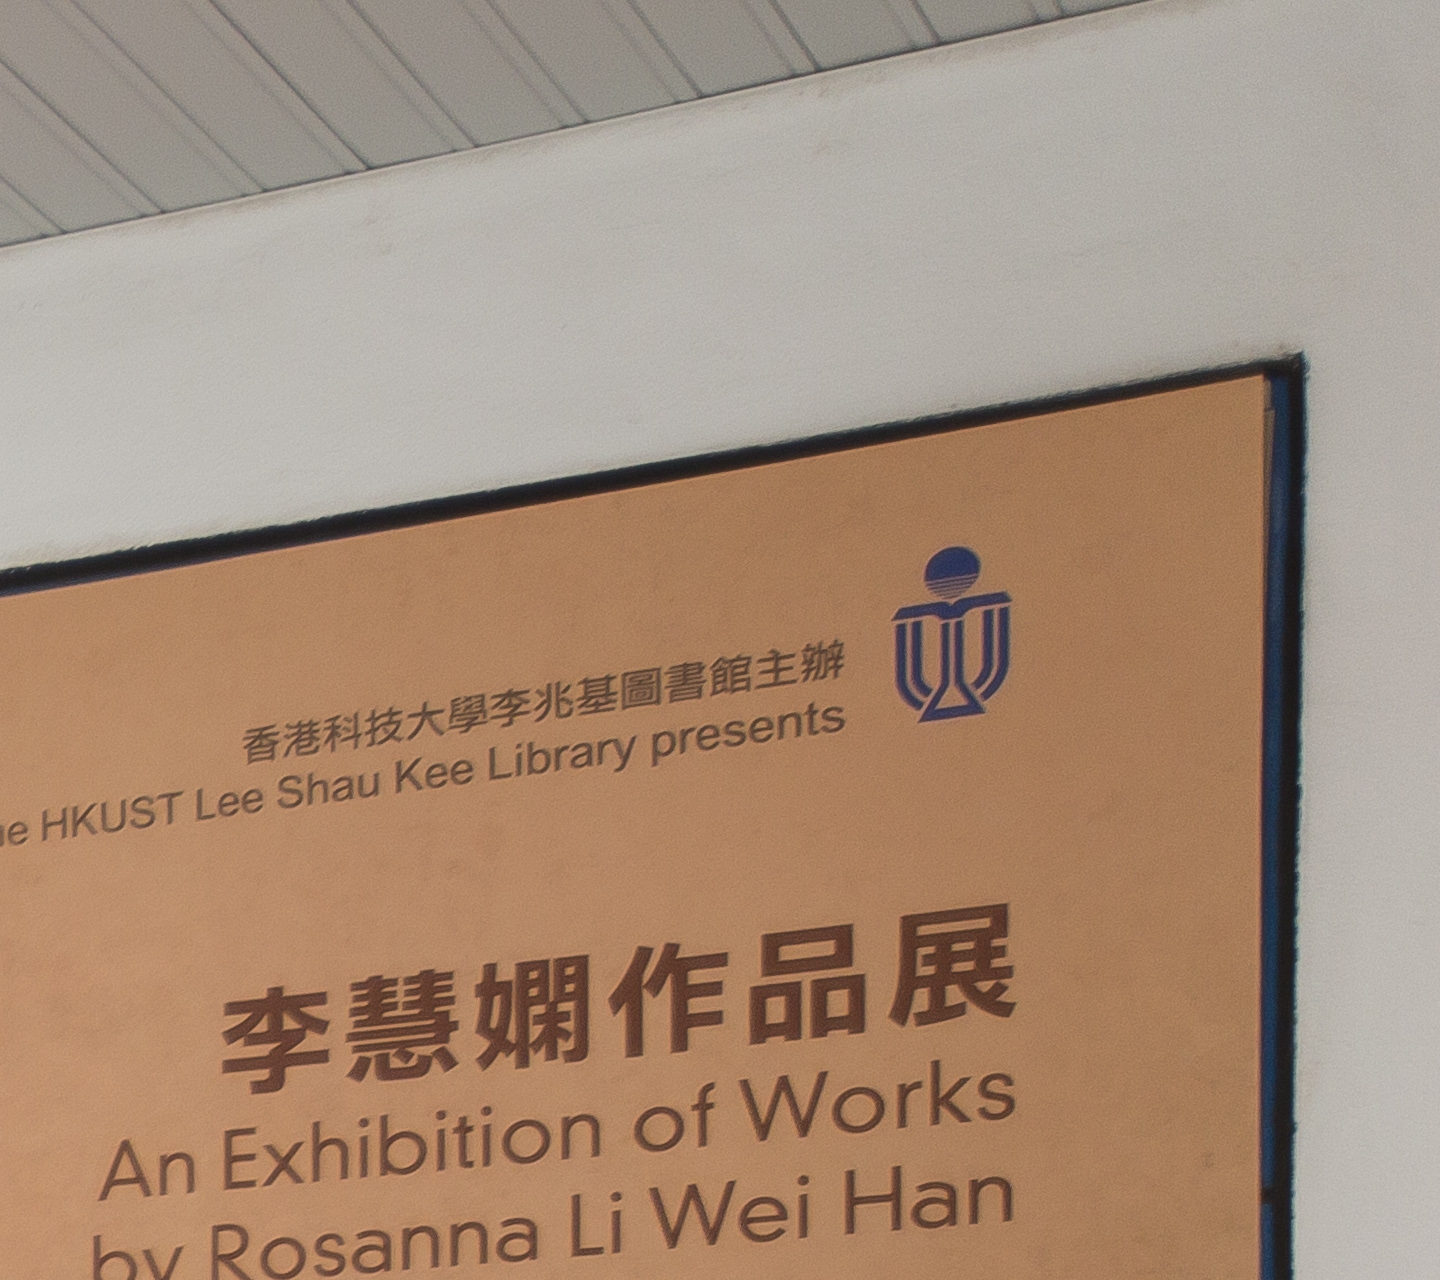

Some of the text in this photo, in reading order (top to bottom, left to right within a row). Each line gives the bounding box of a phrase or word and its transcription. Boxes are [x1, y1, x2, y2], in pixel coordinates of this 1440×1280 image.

[41, 790, 184, 842] HKUST
[196, 788, 264, 821] Lee
[277, 772, 380, 809] Shau
[395, 757, 474, 794] Kee
[488, 734, 637, 781] Library
[650, 702, 846, 767] presents
[243, 638, 846, 766] 香港科技大學李兆基圖書館主辦
[221, 902, 1018, 1095] 李慧嫻作品展
[98, 1059, 1016, 1202] An Exhibition of Works
[571, 1191, 623, 1257] Li
[649, 1174, 810, 1250] Wei
[845, 1165, 1013, 1235] Han
